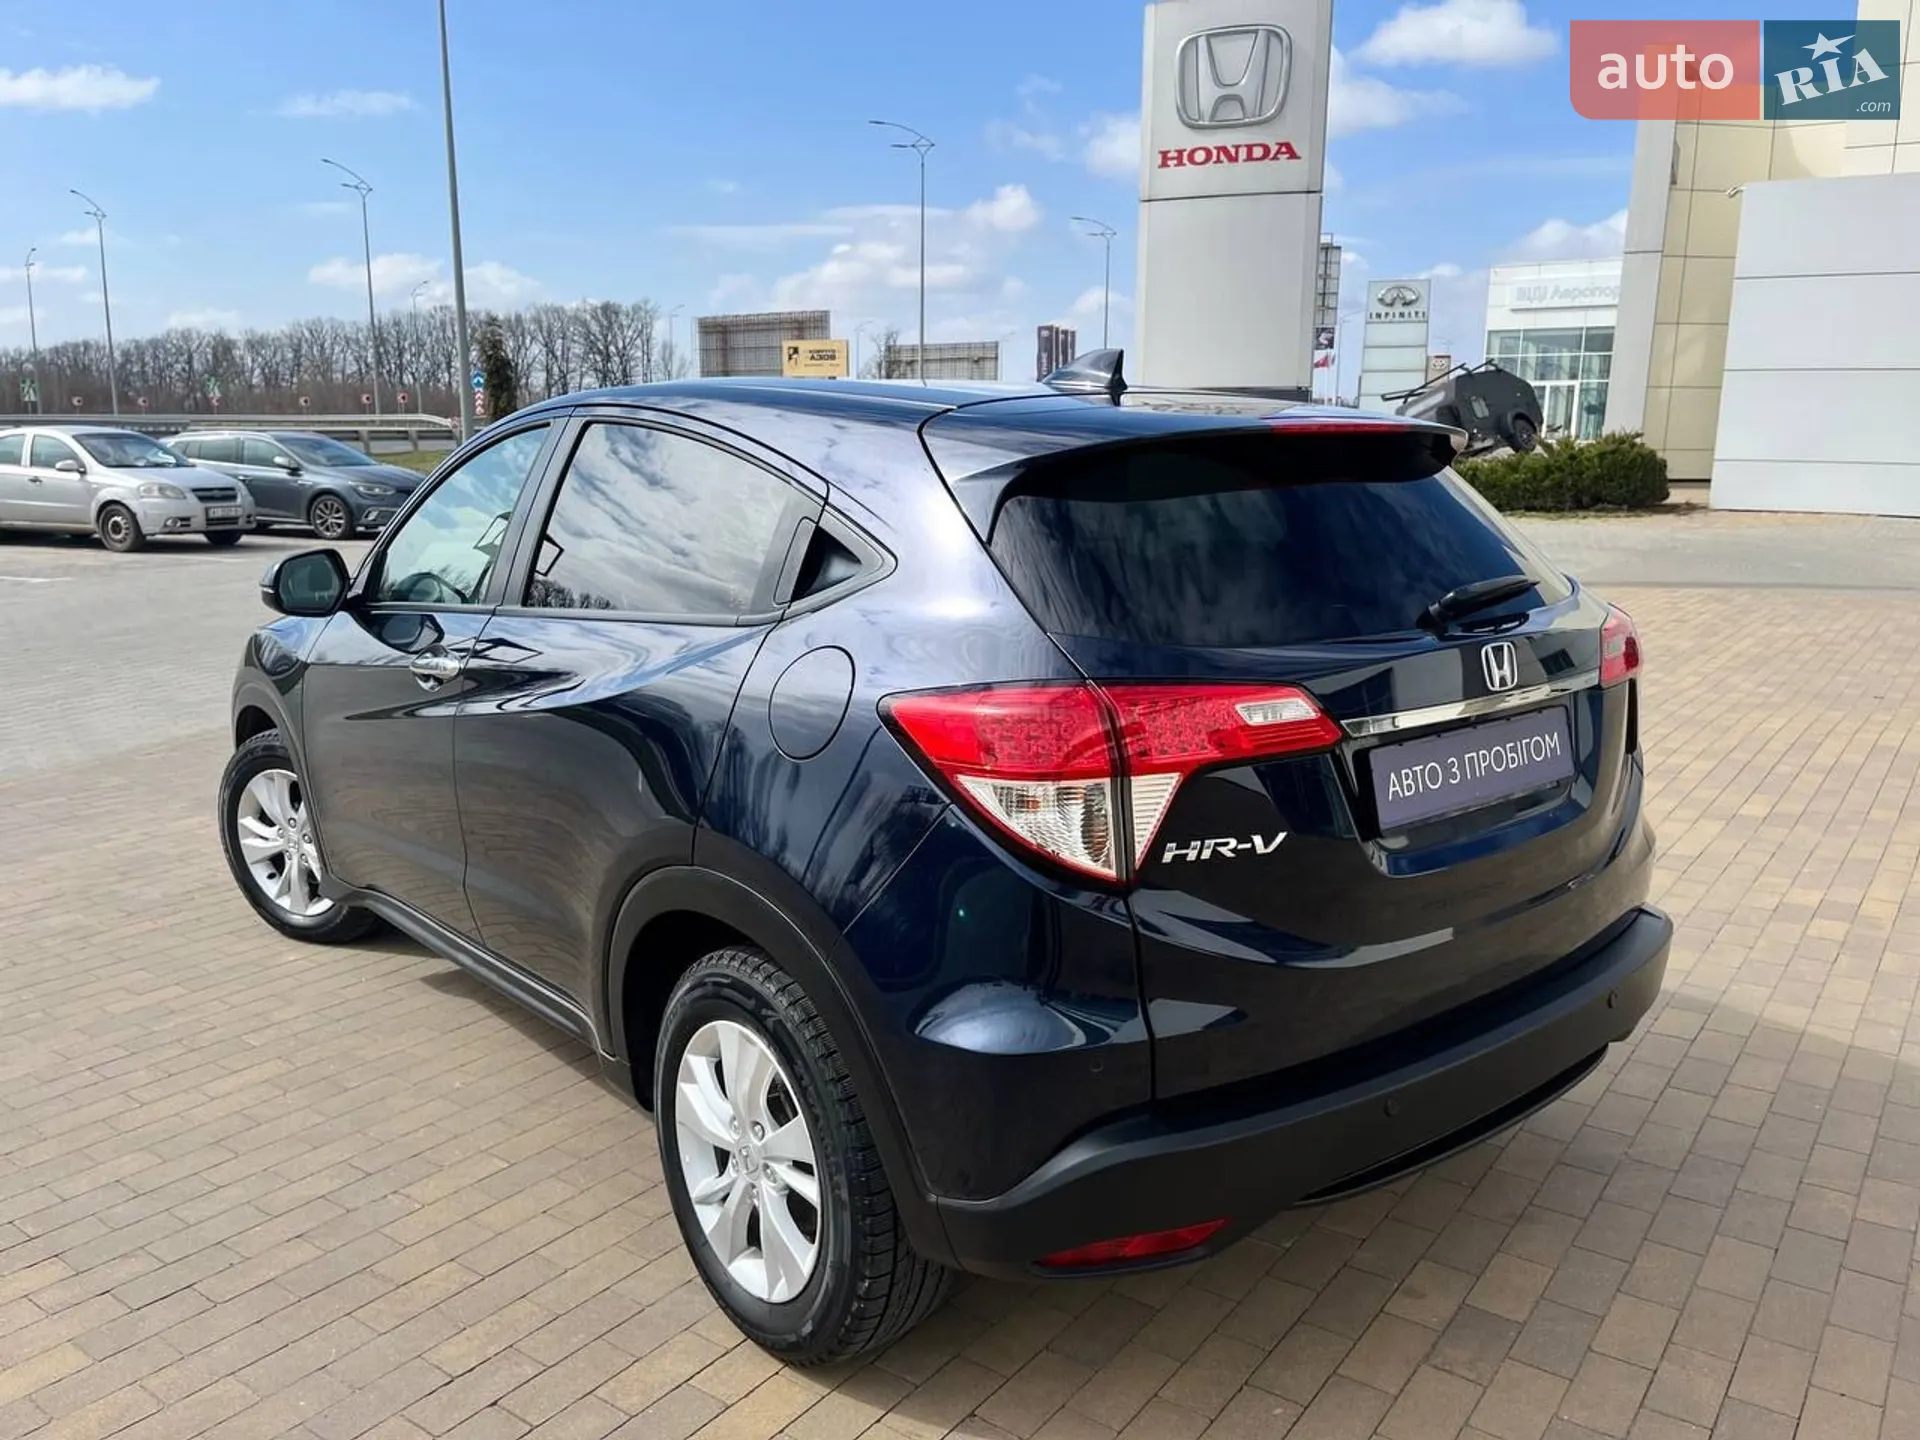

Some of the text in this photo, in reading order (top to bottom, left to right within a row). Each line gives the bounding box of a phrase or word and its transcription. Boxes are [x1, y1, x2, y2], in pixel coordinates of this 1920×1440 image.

[1157, 140, 1302, 169] HONDA
[1388, 761, 1443, 802] АВТО
[1464, 731, 1561, 780] ПРОБІГОМ
[1161, 831, 1288, 864] HR-V
